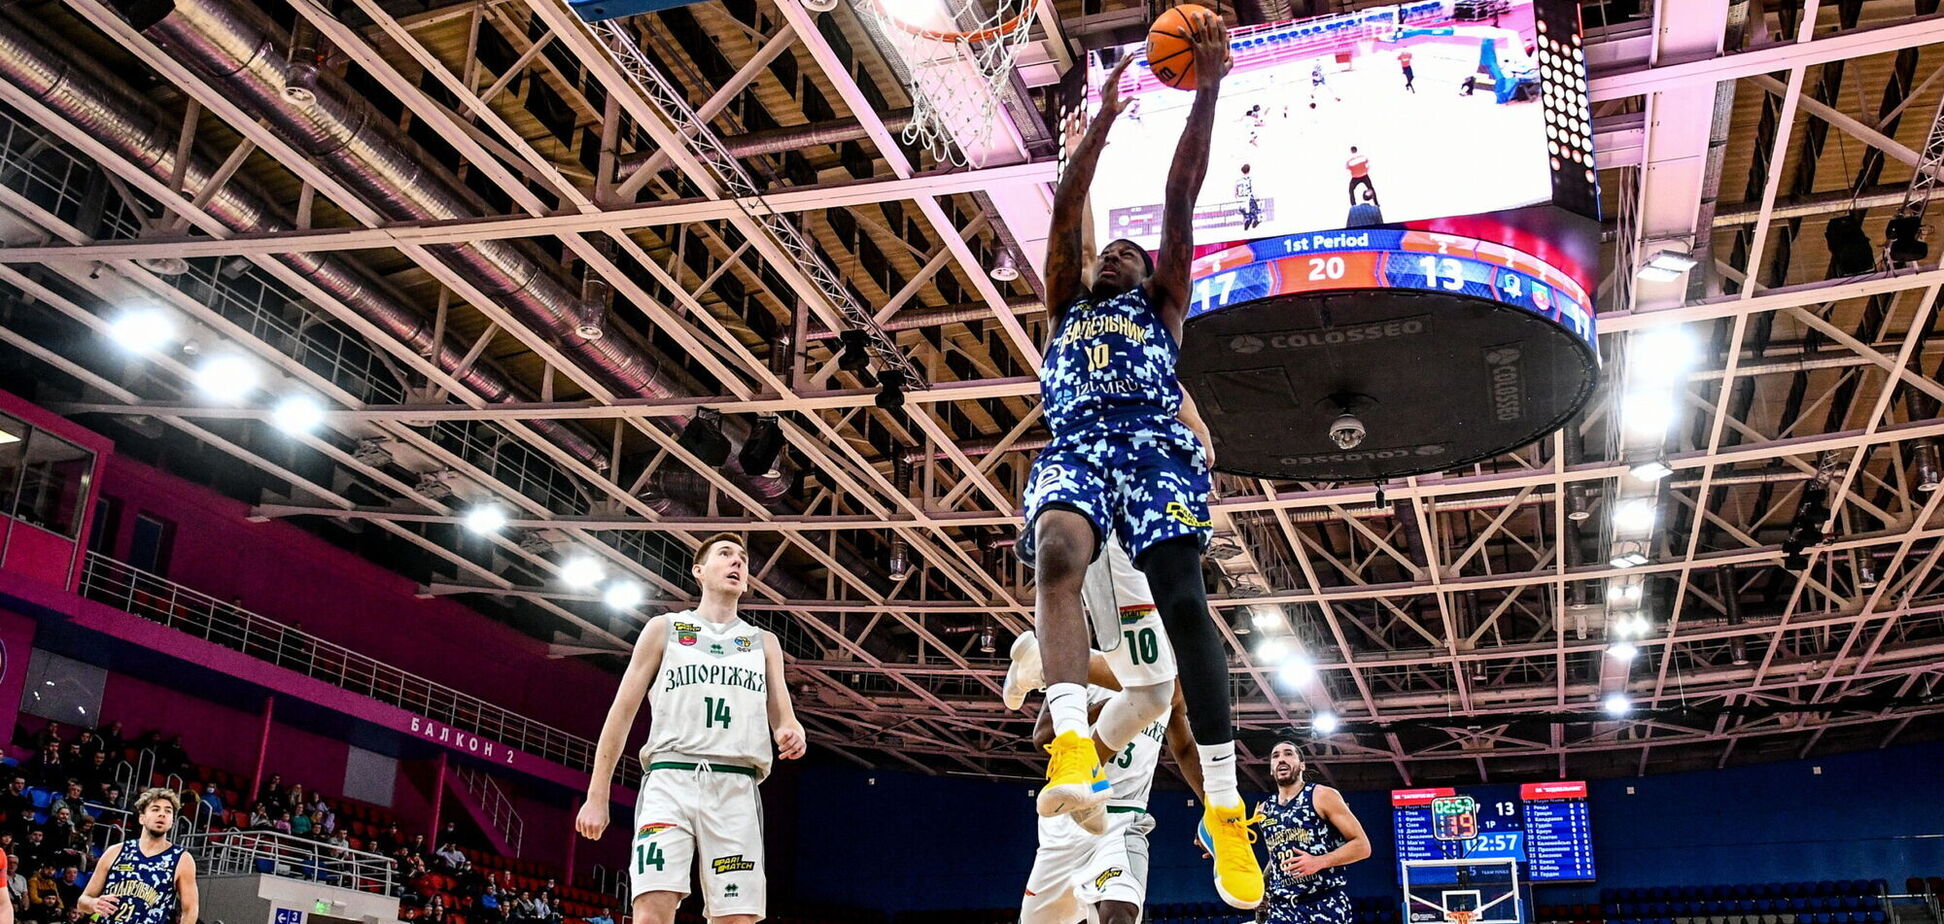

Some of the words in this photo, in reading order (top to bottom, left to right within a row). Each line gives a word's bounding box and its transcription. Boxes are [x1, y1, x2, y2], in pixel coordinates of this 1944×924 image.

[1283, 238, 1309, 253] 1st
[1313, 232, 1369, 250] Period
[1308, 256, 1345, 281] 20
[1419, 255, 1465, 291] 13
[1195, 271, 1237, 311] 17
[1270, 319, 1424, 350] COLOSSEO
[1084, 343, 1109, 372] 10
[1492, 364, 1521, 421] COLOSSEO
[1280, 449, 1409, 465] COLOSSEO
[1124, 627, 1159, 665] 10
[704, 696, 731, 729] 14
[410, 717, 493, 757] БАЛКОН
[506, 750, 514, 764] 2
[1495, 801, 1515, 816] 13
[1485, 821, 1496, 829] 1P
[1465, 834, 1518, 852] 02:57
[636, 841, 665, 875] 14
[719, 862, 754, 872] MATCH
[114, 902, 135, 922] 21
[292, 912, 298, 921] 3
